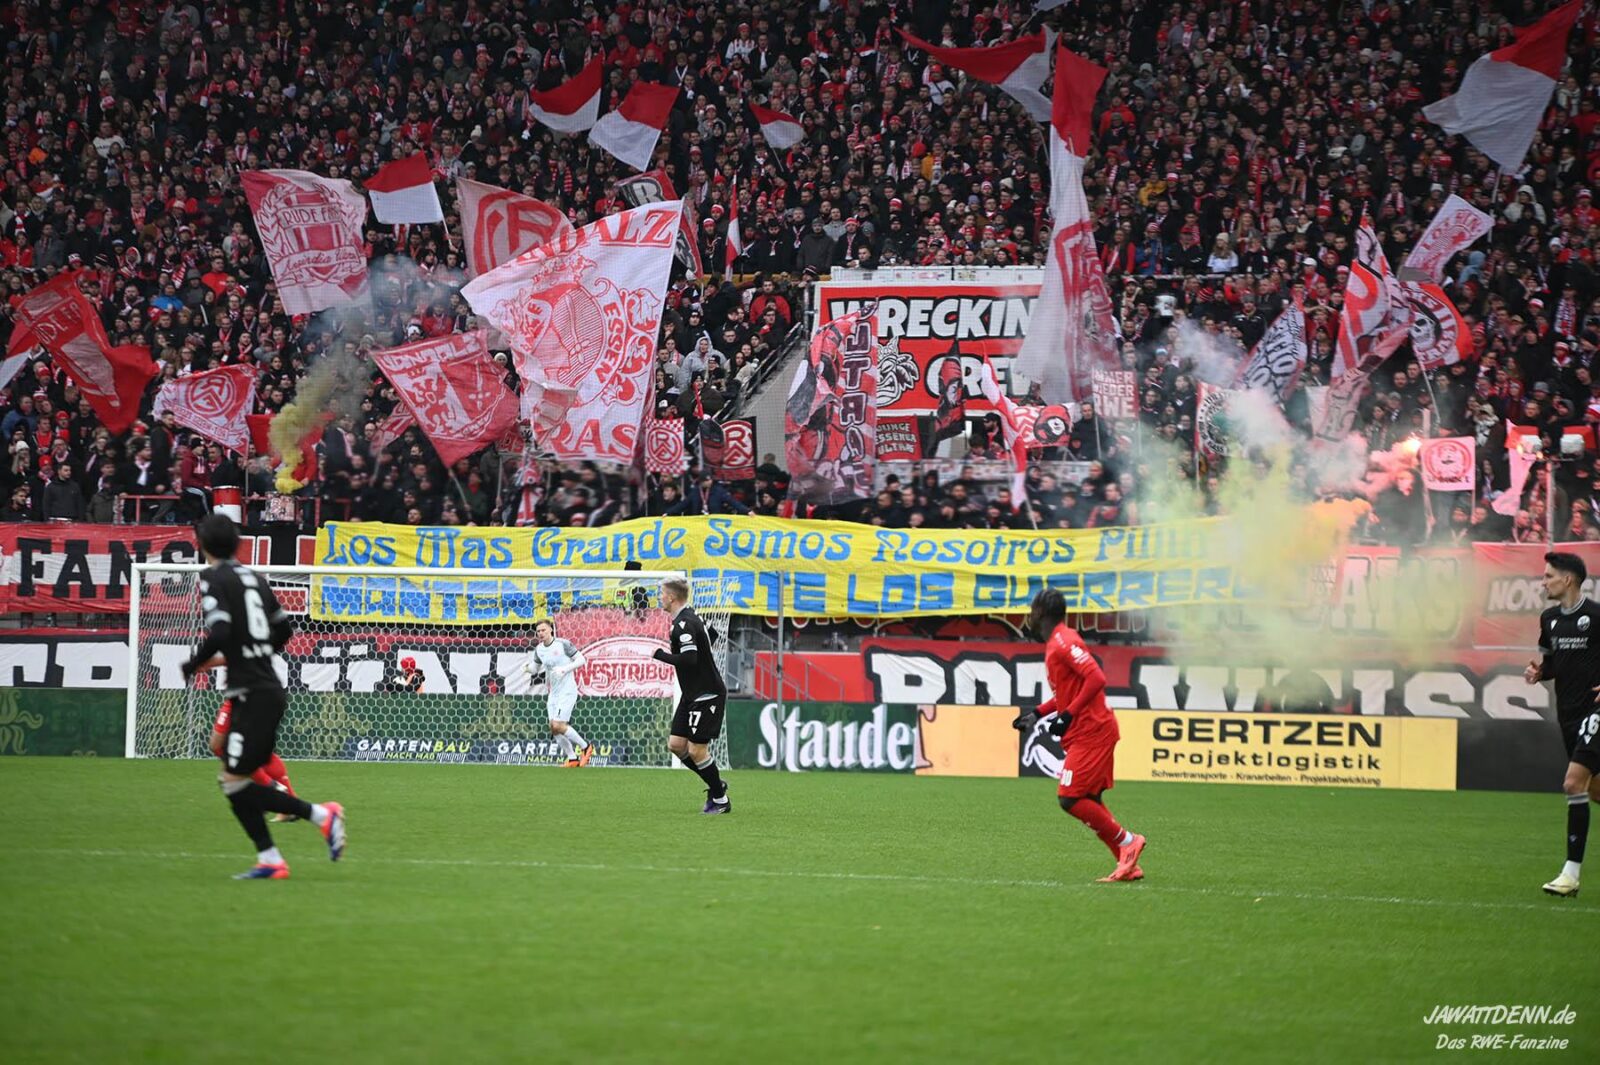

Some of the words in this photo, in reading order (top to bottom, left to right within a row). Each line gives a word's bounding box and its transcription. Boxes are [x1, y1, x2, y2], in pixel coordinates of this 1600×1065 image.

[830, 297, 1038, 338] WRECKIN
[595, 302, 625, 384] ESSEN
[324, 524, 396, 566] Los
[532, 520, 687, 568] Grande
[704, 518, 852, 560] Somos
[872, 529, 1075, 566] Nosotros
[16, 538, 198, 598] FANS
[848, 573, 955, 615] LOS
[973, 566, 1258, 609] GUERRER
[244, 588, 270, 641] 6
[688, 711, 702, 728] 17
[1152, 717, 1382, 748] GERTZEN
[227, 731, 245, 757] 6
[357, 739, 471, 753] GARTENBAU
[386, 751, 412, 760] NACH
[1152, 748, 1381, 772] Projektlogistik
[1151, 769, 1228, 781] Schwertransporte
[1235, 773, 1292, 783] Kranarbeiten
[1300, 774, 1382, 787] Projektabwicklung
